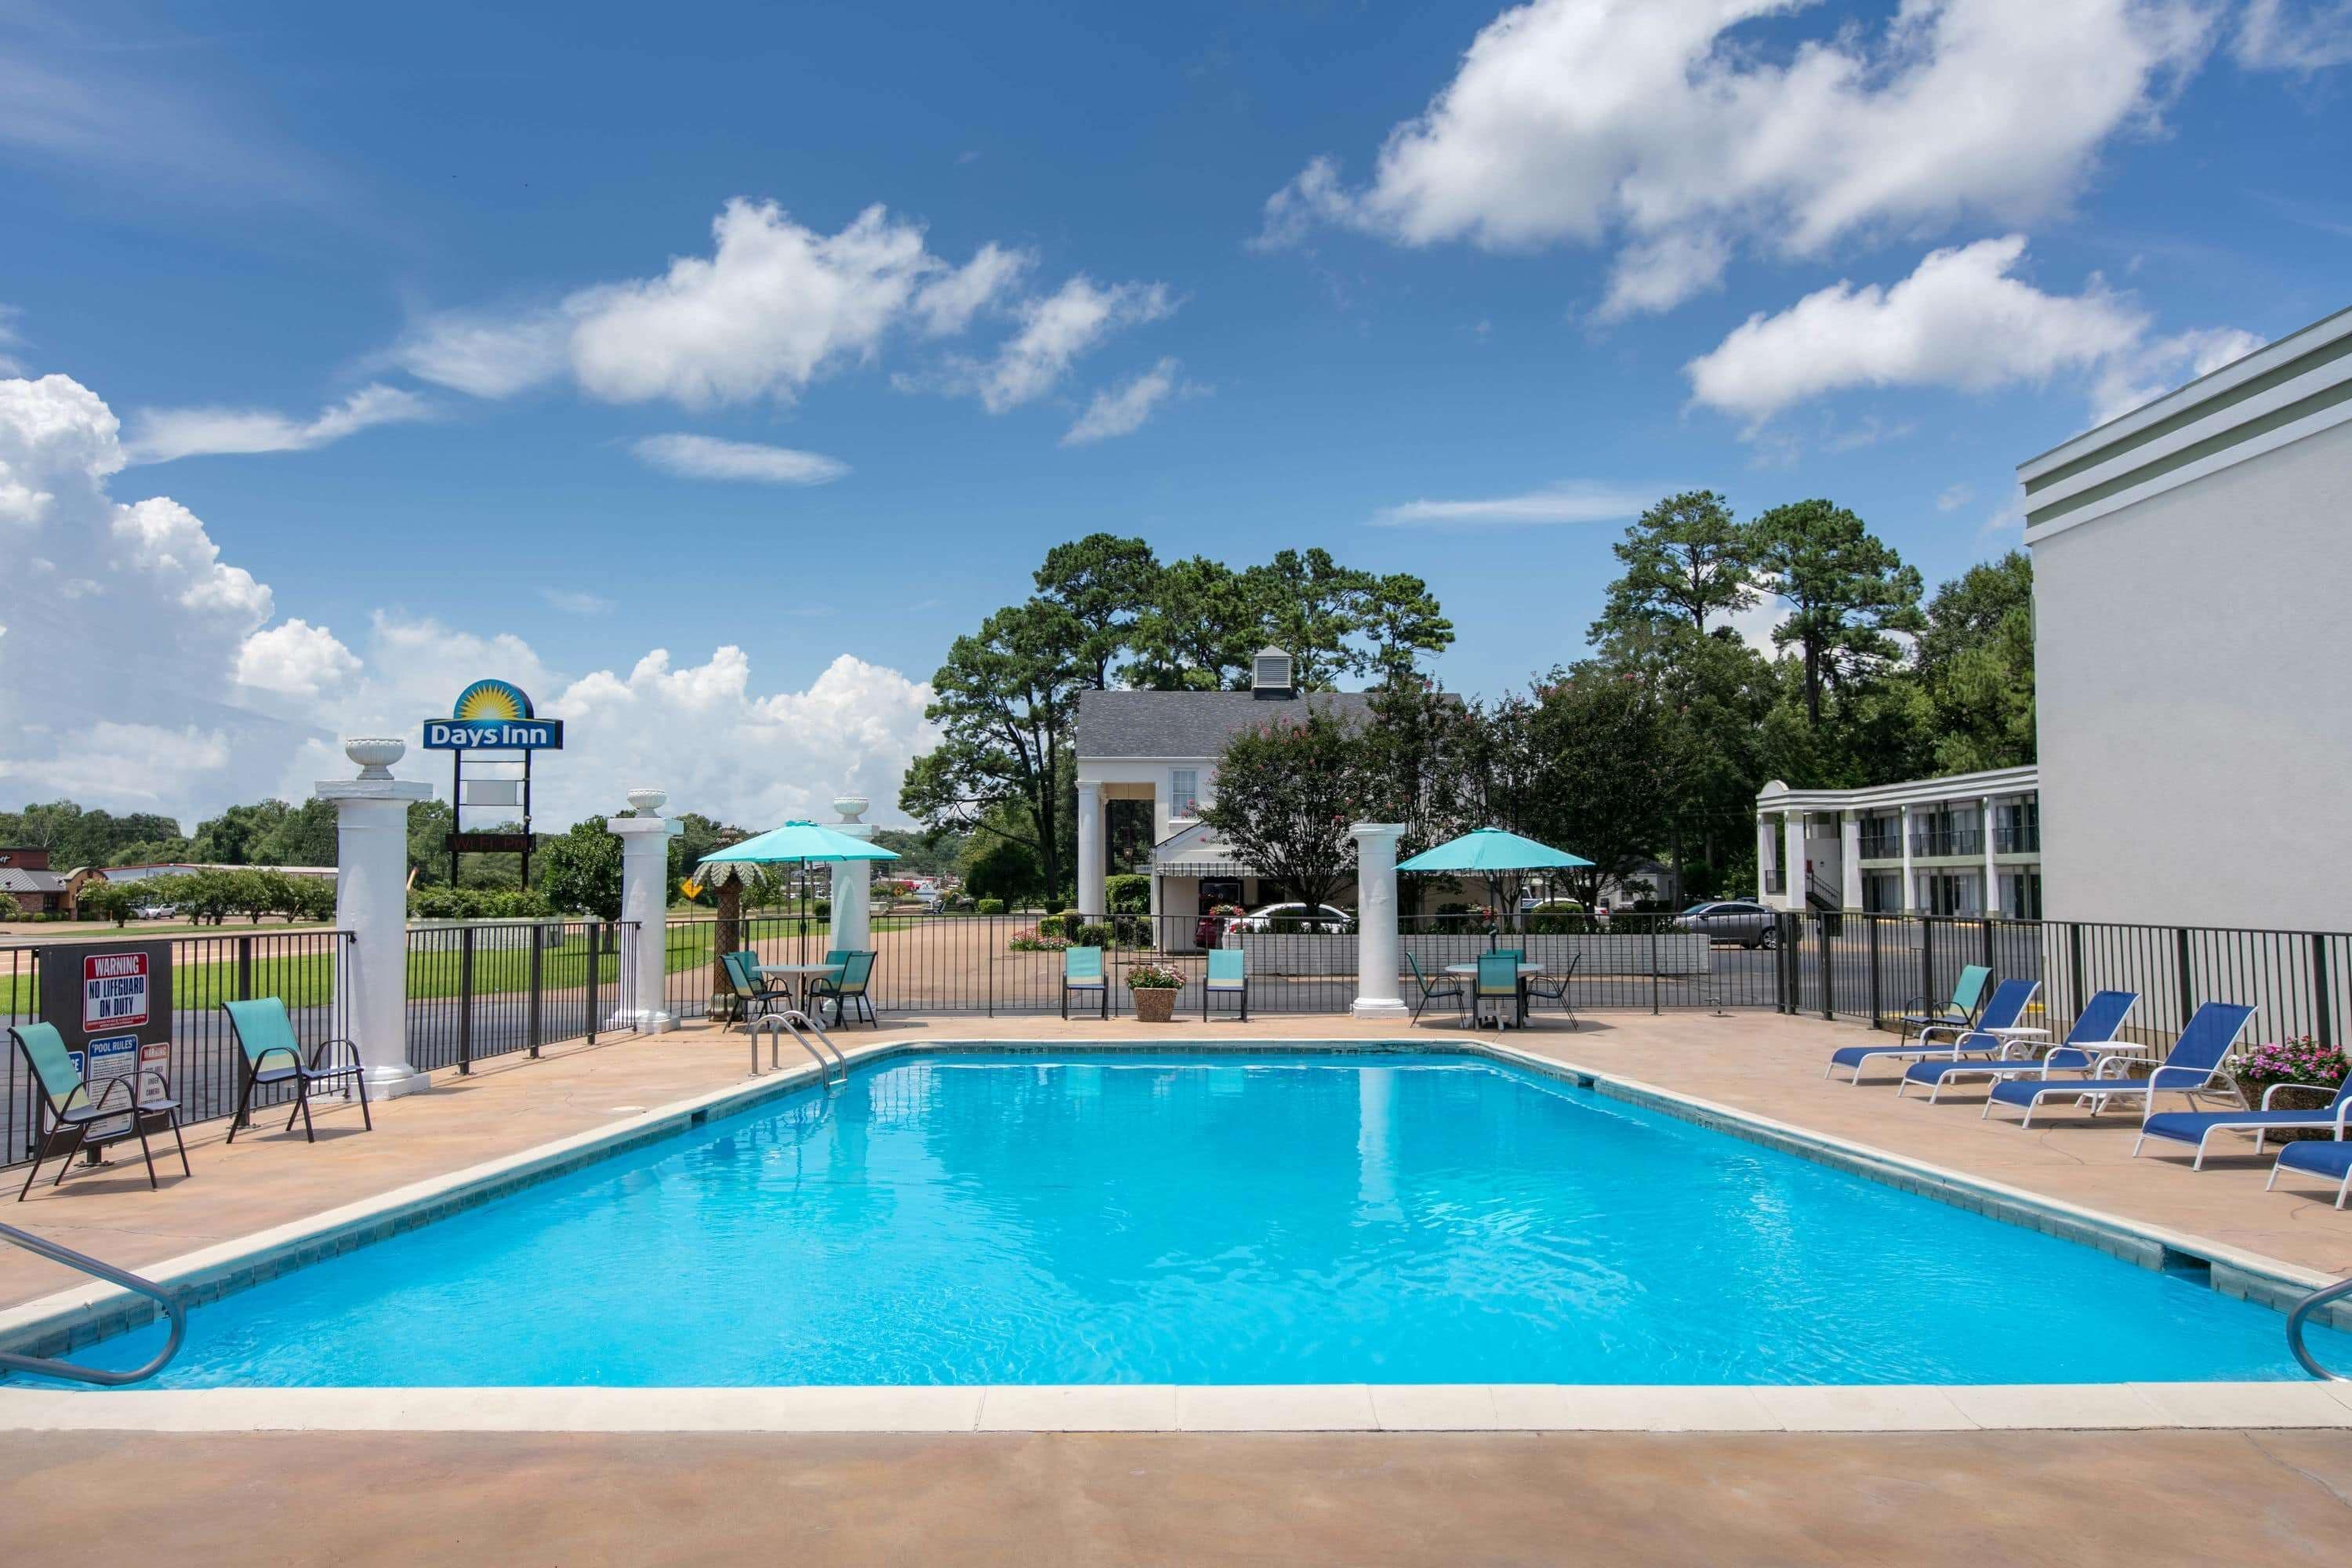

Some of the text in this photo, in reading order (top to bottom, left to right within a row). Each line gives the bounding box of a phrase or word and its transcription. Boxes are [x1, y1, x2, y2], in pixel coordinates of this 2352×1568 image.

[431, 724, 547, 747] Days Inn
[95, 956, 139, 977] WARNING
[89, 977, 144, 999] NO LIFEGUARD
[100, 996, 133, 1017] ON DUTY
